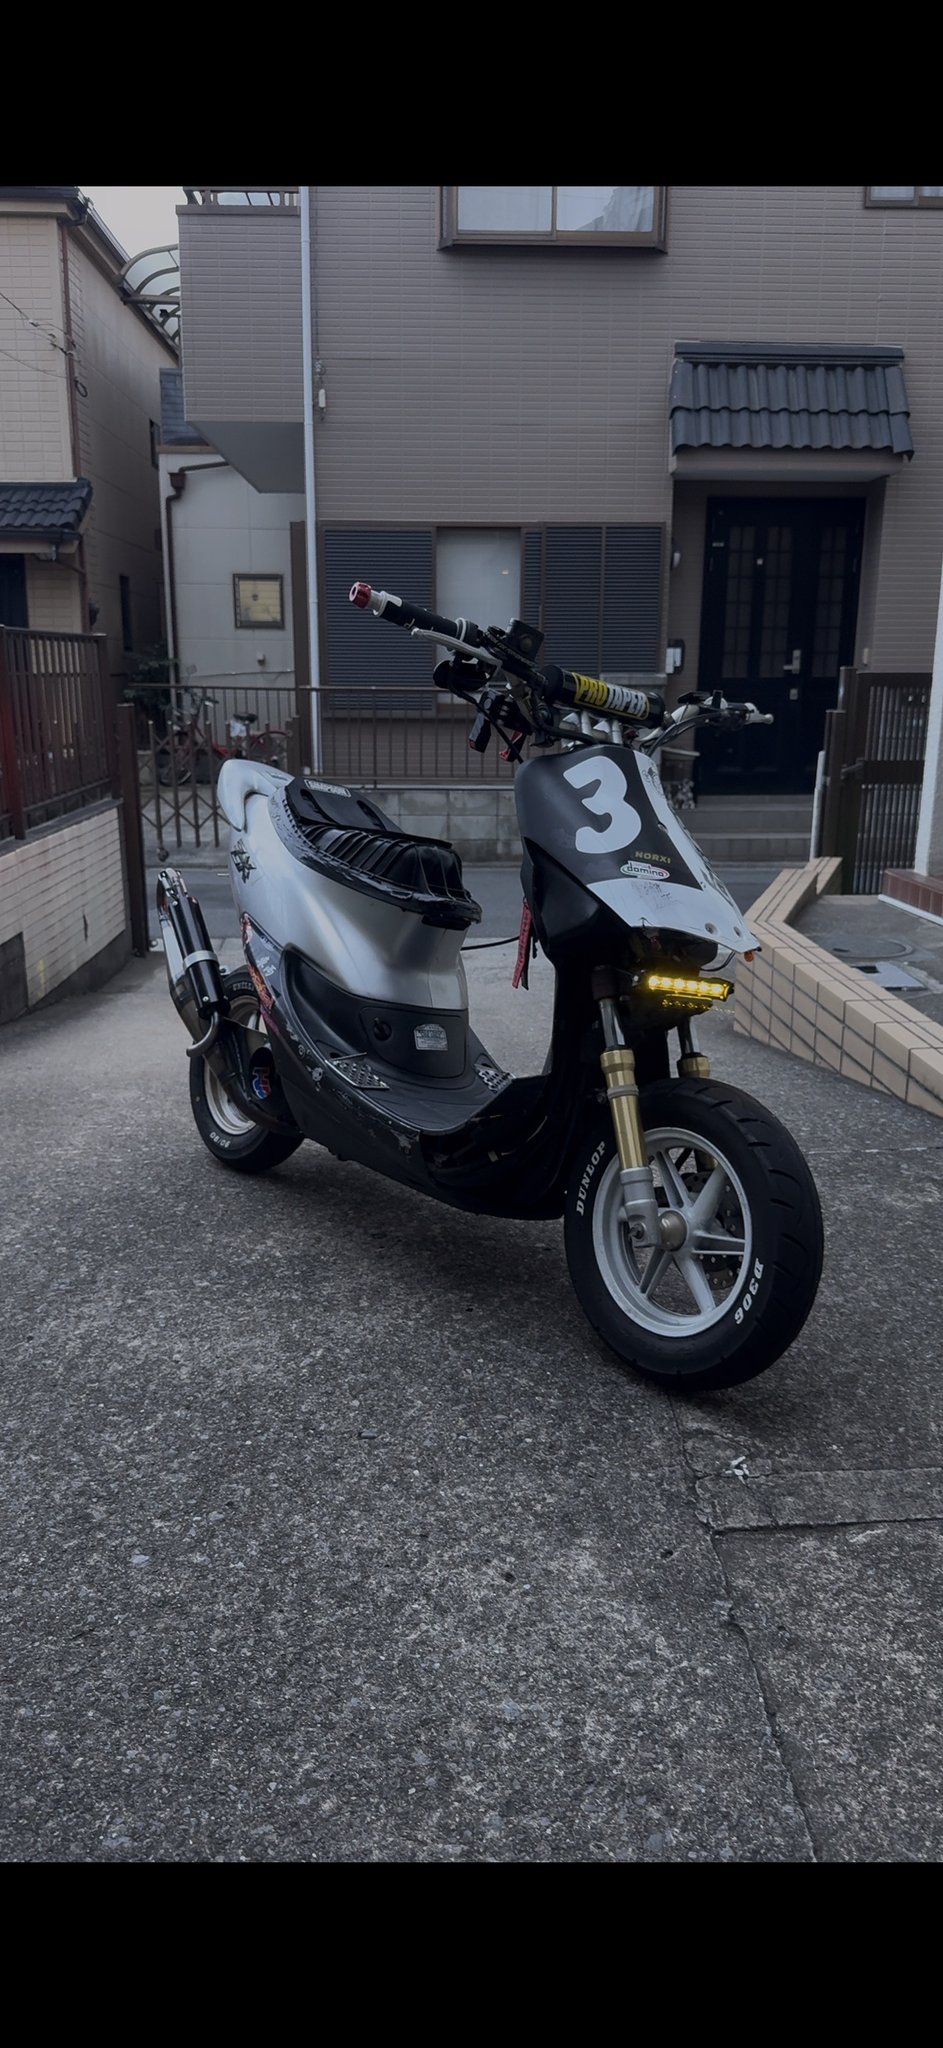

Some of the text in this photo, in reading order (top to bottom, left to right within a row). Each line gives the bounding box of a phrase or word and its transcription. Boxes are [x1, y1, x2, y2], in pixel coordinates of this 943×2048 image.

[563, 755, 642, 854] 3
[627, 862, 664, 877] domino
[576, 1141, 606, 1216] DUNLOP
[734, 1257, 764, 1325] D306
